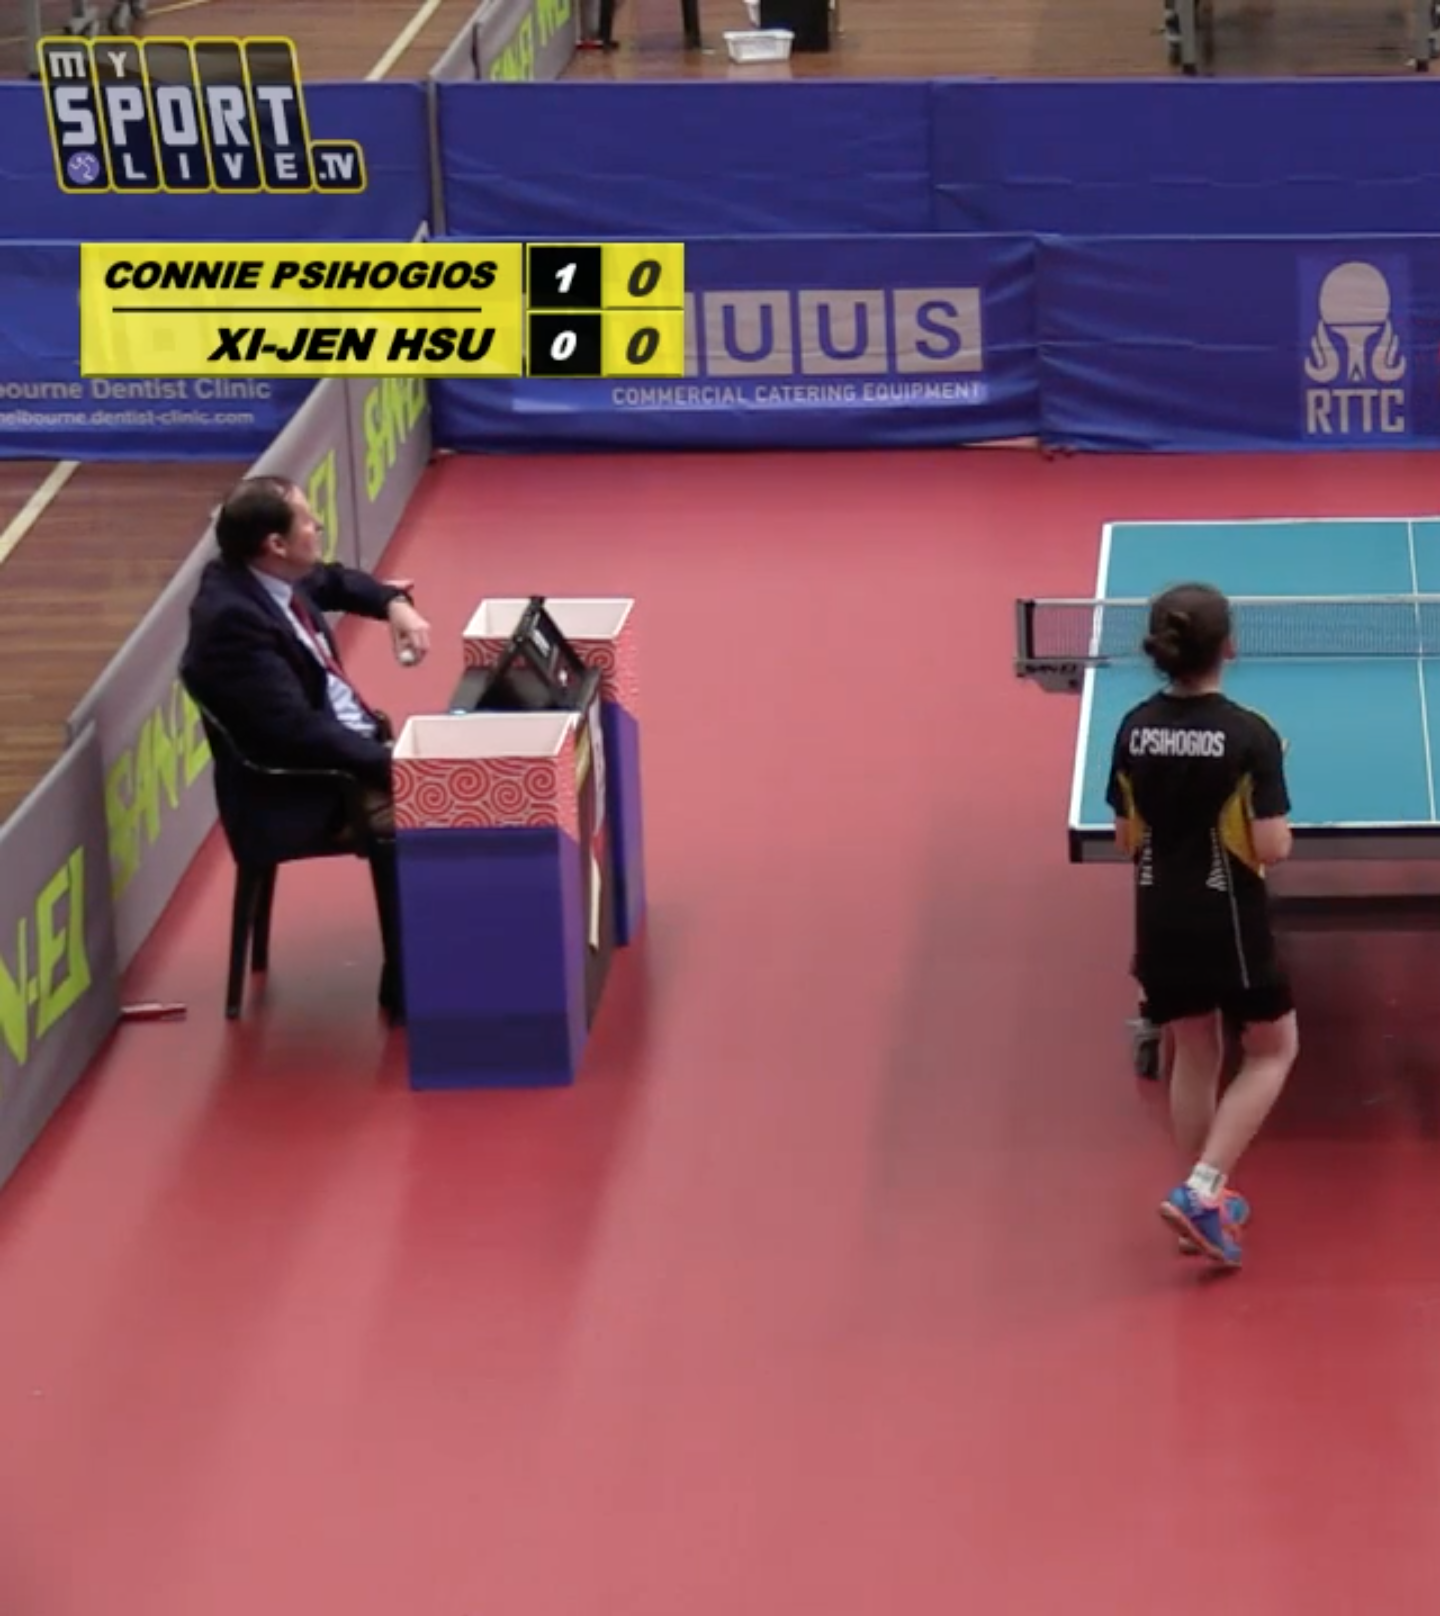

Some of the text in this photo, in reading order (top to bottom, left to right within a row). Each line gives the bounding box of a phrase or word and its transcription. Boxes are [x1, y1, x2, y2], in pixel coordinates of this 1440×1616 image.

[718, 298, 966, 366] UUS
[92, 378, 189, 399] Dentist
[201, 377, 272, 399] Clinic
[612, 381, 981, 406] COMMERCIAL CATERING EQUIPMENT
[1306, 388, 1405, 434] RTTC
